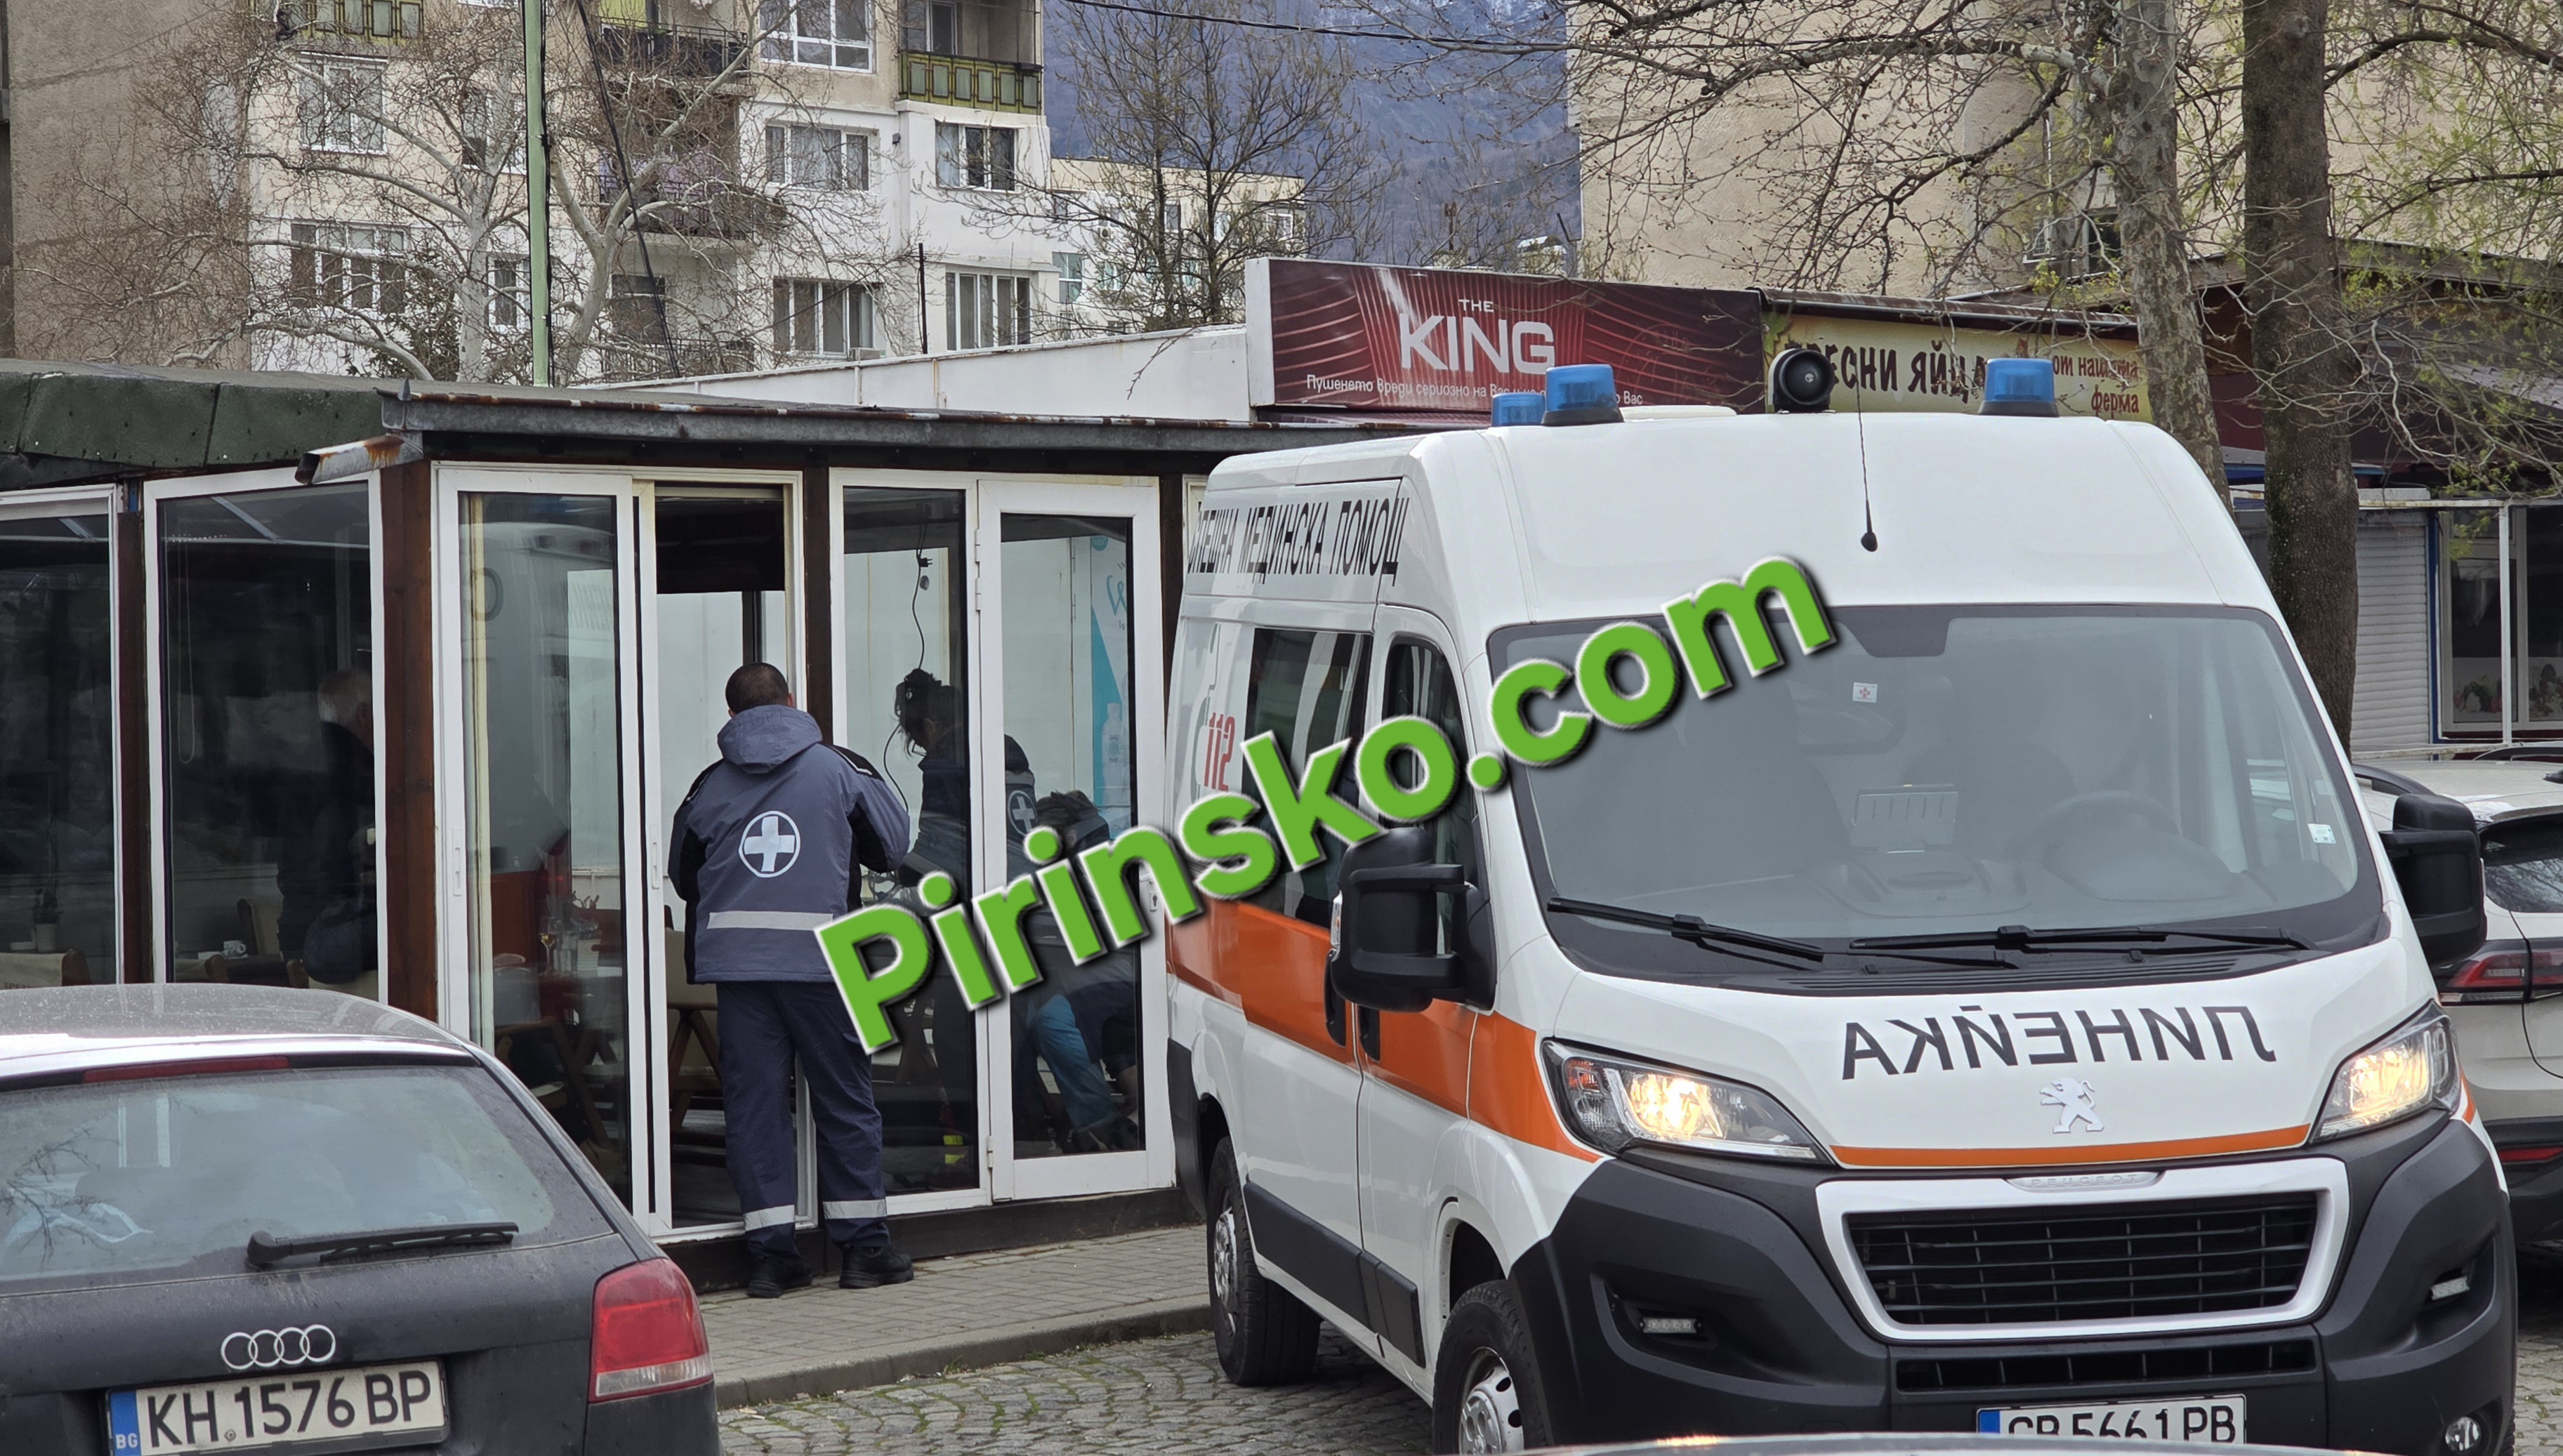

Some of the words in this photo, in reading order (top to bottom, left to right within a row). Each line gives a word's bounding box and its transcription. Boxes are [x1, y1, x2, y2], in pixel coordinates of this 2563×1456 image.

[1458, 299, 1494, 312] THE
[1399, 313, 1555, 375] KING
[1784, 339, 1898, 392] ЕСНИ
[2053, 355, 2074, 376] от
[1307, 374, 1373, 393] Пушенето
[1416, 384, 1470, 397] сериозно
[1474, 386, 1487, 397] на
[1623, 391, 1643, 405] Вас
[2091, 384, 2140, 419] ферма
[1330, 498, 1410, 587] ПОМОЩ
[1204, 712, 1234, 792] 112
[2031, 1174, 2137, 1188] PEUGEOT
[116, 1433, 138, 1449] BG
